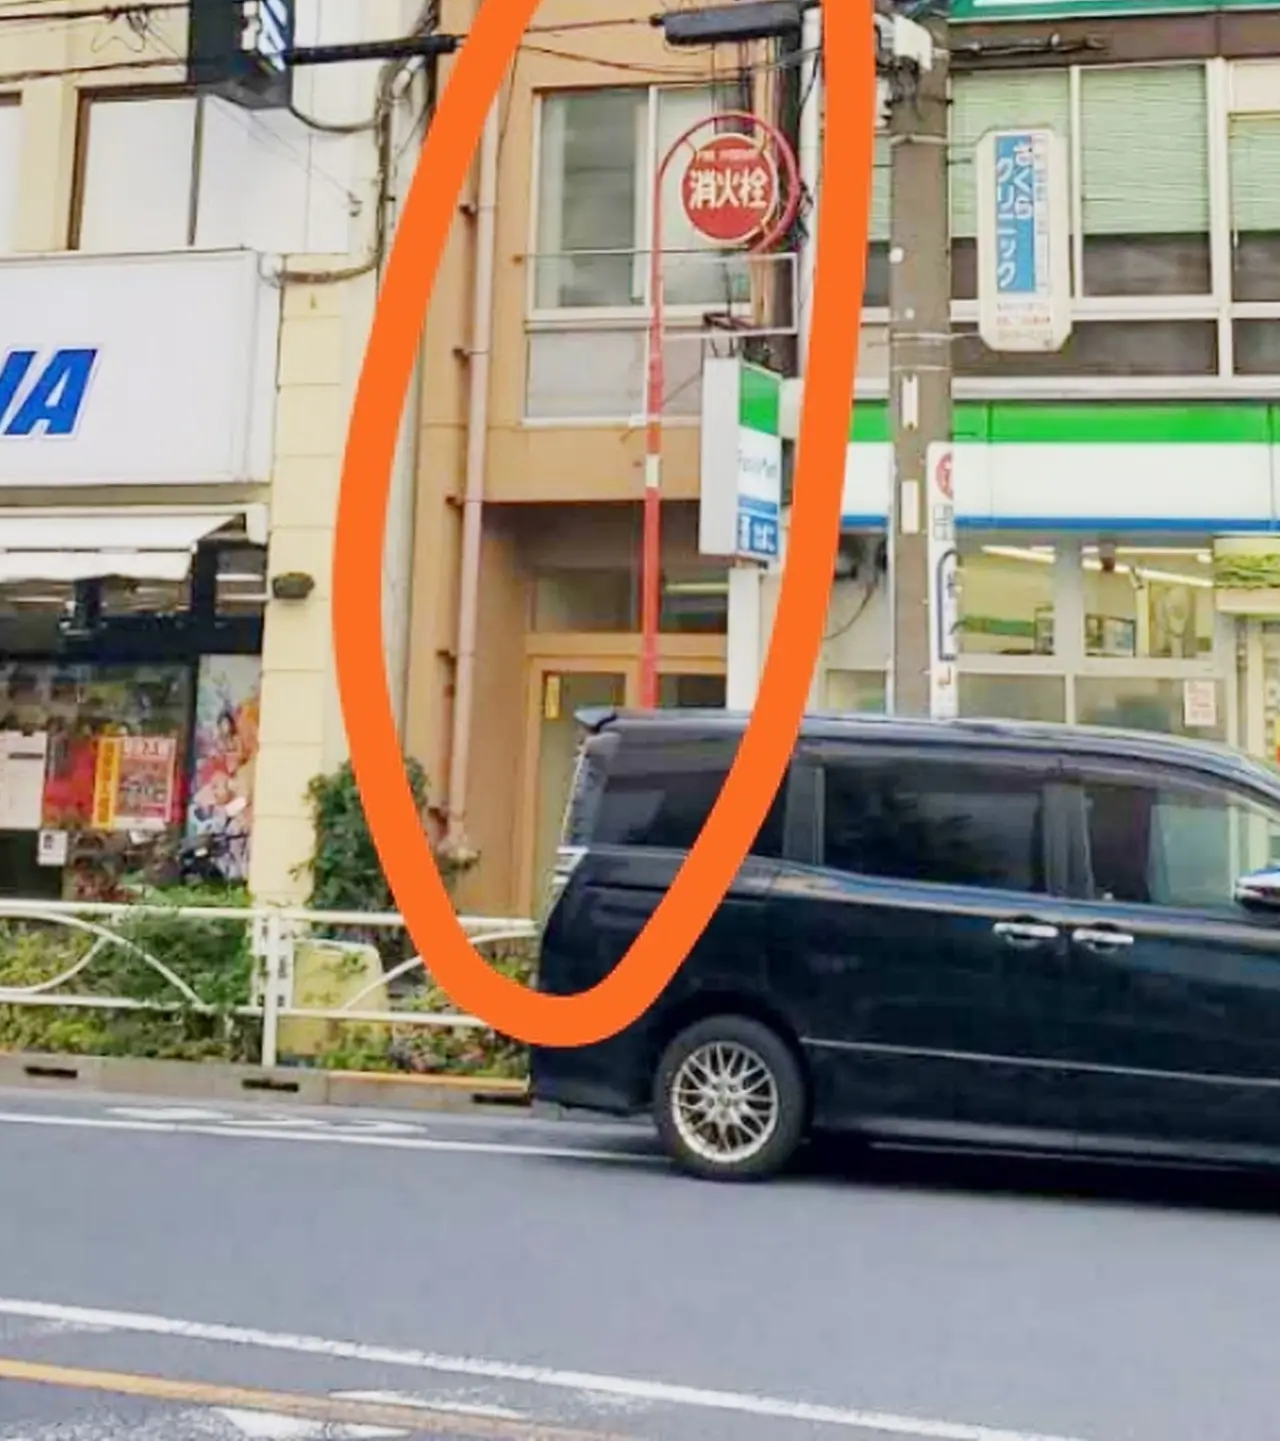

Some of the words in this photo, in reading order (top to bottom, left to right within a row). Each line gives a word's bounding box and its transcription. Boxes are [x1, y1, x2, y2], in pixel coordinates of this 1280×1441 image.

[688, 164, 770, 211] 消火栓
[996, 156, 1018, 289] クリニック
